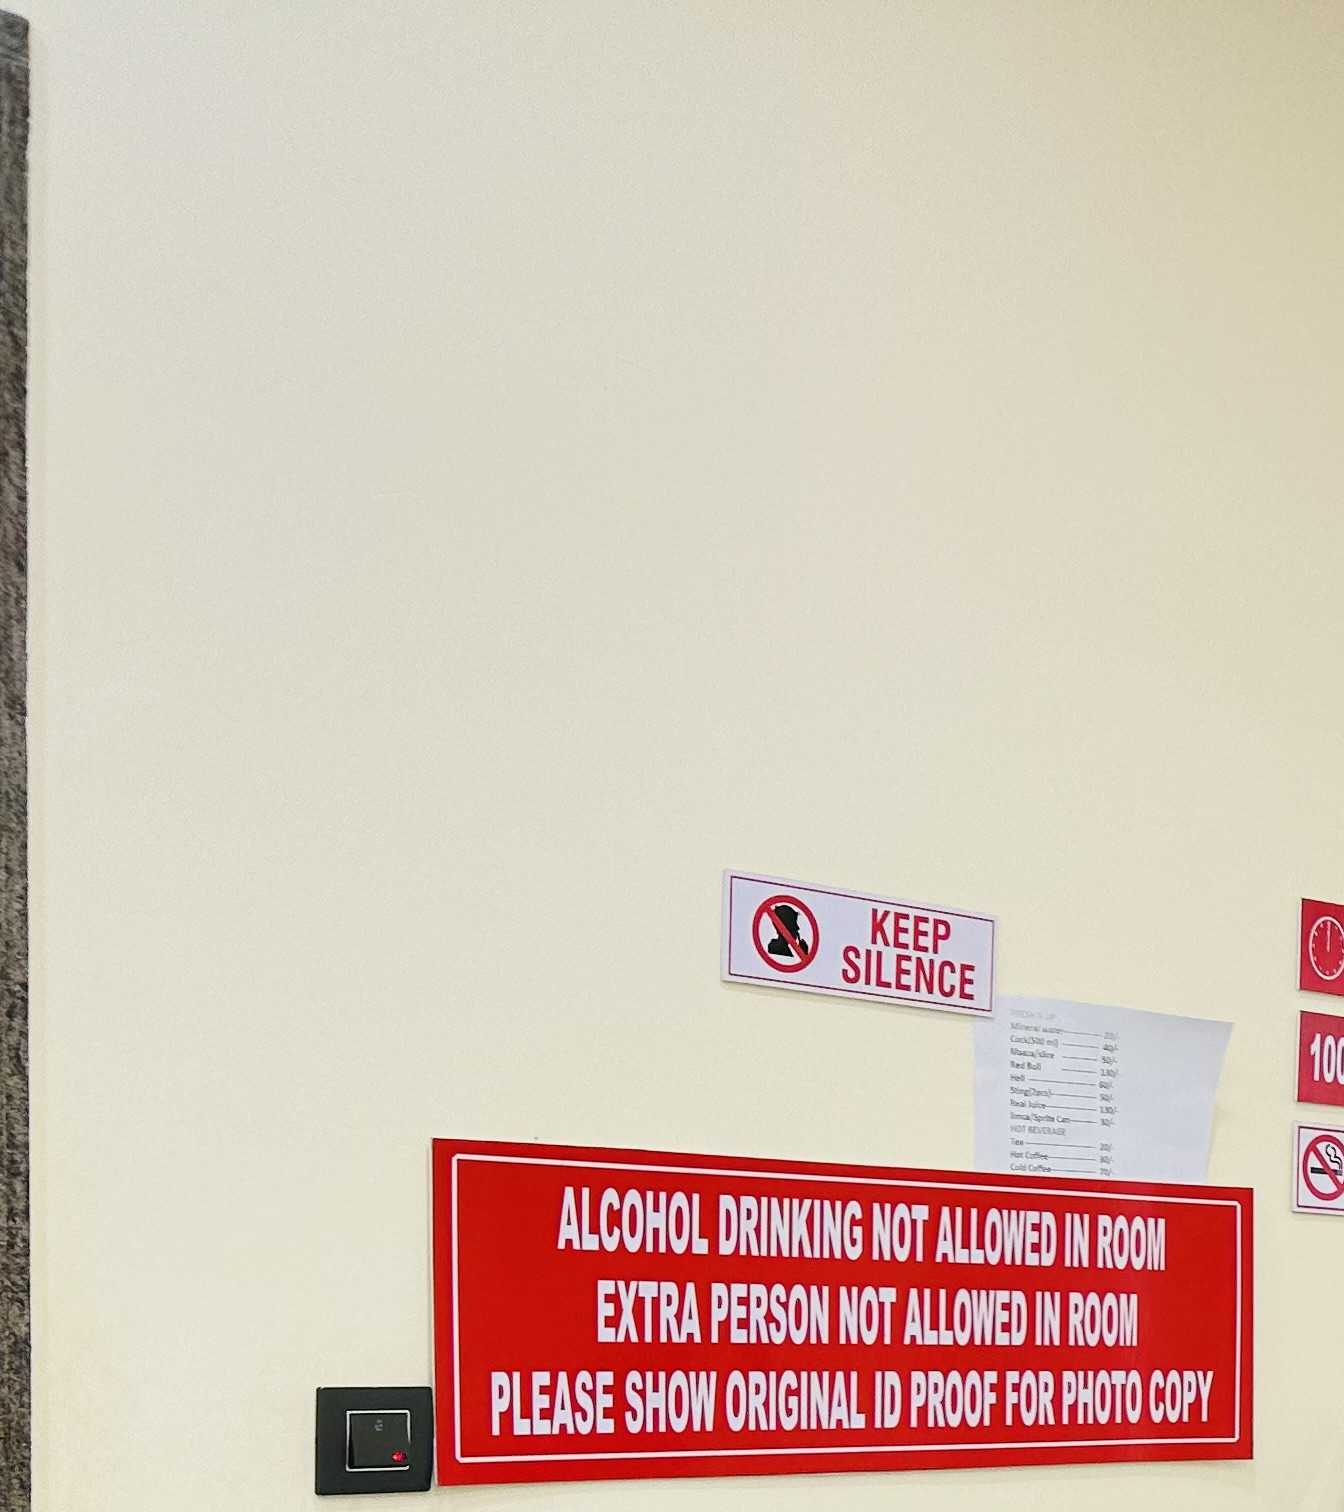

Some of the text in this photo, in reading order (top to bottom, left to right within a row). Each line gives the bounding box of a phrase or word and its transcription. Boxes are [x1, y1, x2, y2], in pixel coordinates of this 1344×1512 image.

[870, 907, 952, 954] KEEP
[841, 946, 976, 1001] SILENCE
[557, 1186, 1166, 1271] ALCOHOL DRINKING NOT ALLOWED IN ROOM
[597, 1280, 1138, 1347] EXTRA PERSON NOT ALLOWED IN ROOM
[491, 1369, 1214, 1436] PLEASE SHOW ORIGINAL ID PROOF FOR PHOTO COPY
